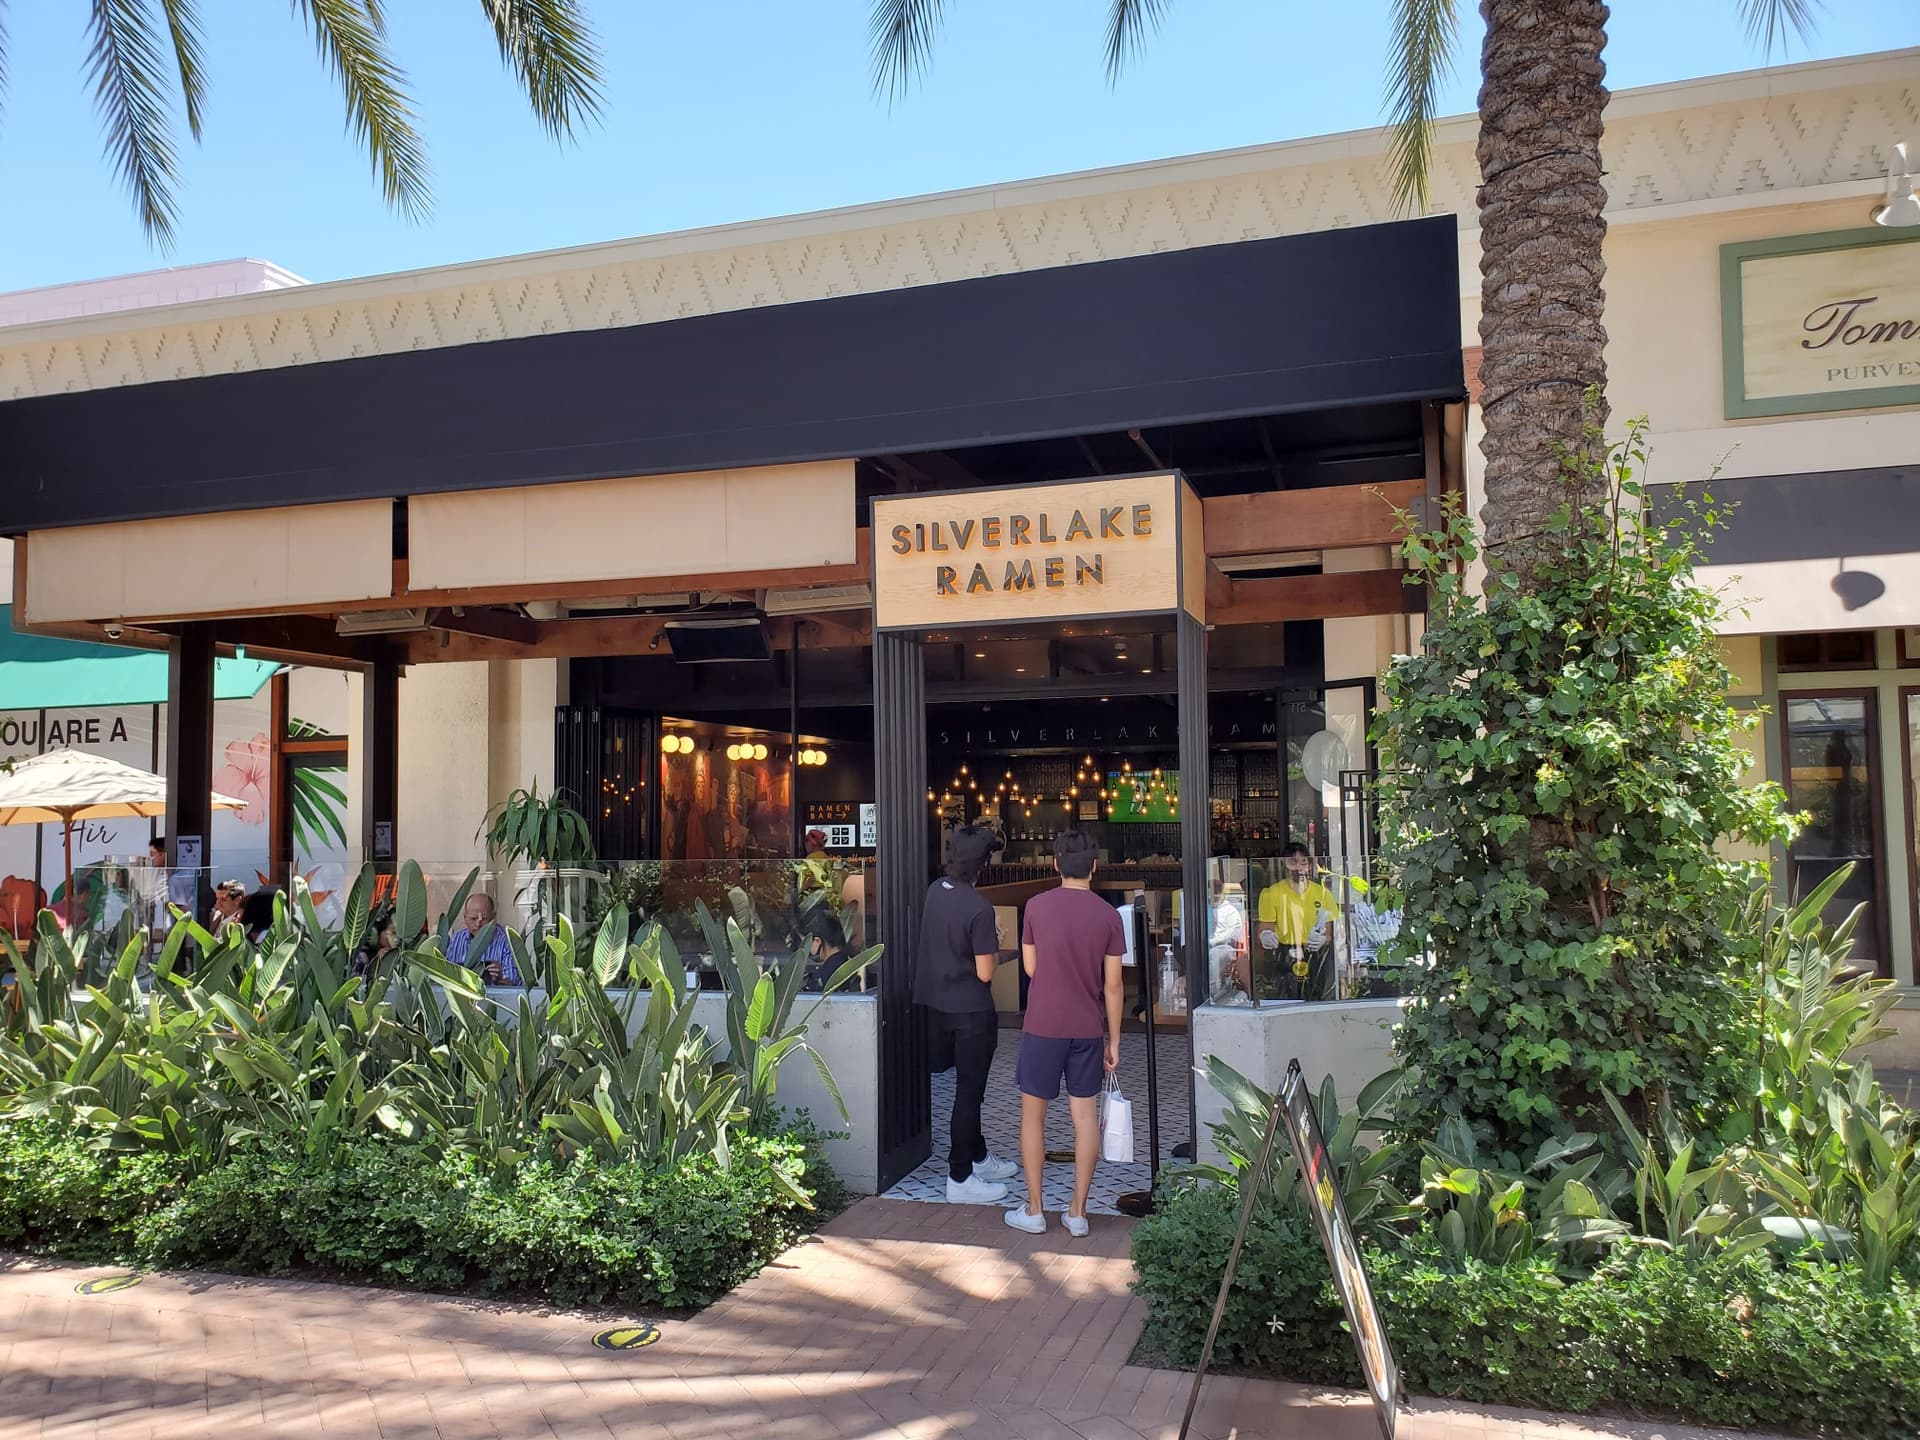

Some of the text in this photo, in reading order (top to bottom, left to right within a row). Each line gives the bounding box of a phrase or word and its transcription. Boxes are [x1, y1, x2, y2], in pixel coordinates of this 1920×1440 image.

[1801, 297, 1920, 349] Tom
[891, 504, 1152, 555] SILVERLAKE
[936, 553, 1104, 596] RAMEN
[1, 717, 128, 746] OU ARE A
[941, 725, 1180, 744] SILVERLAK
[809, 804, 852, 813] RAMEN
[59, 819, 117, 853] Air
